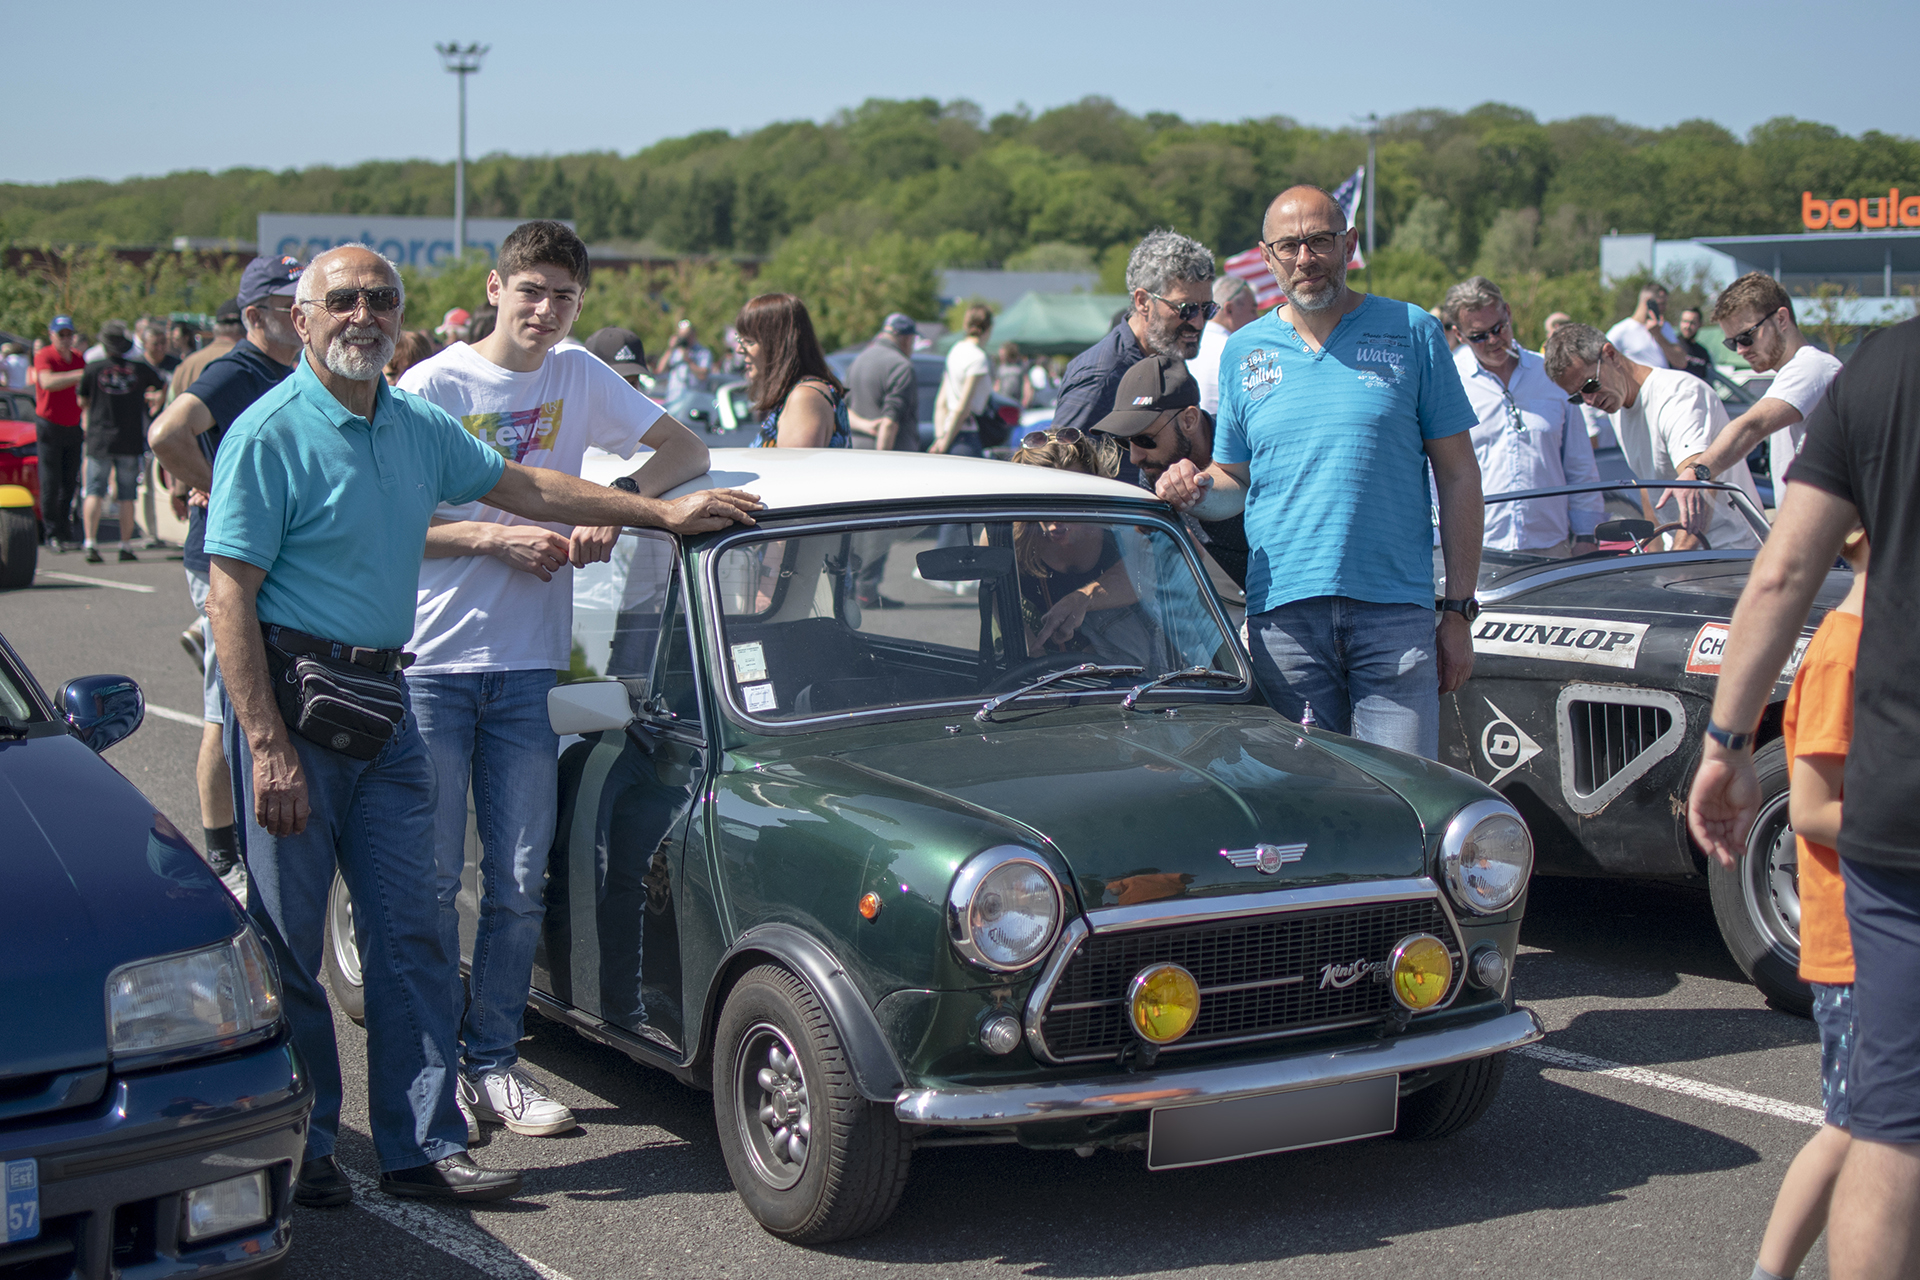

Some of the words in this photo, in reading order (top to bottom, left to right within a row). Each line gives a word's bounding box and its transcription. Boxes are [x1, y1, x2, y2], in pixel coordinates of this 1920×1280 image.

[1356, 347, 1404, 365] Water
[1241, 365, 1283, 392] Sailing
[1473, 621, 1635, 652] DUNLOP
[1489, 733, 1519, 756] D
[10, 1165, 33, 1174] Grand
[10, 1171, 33, 1186] Est
[9, 1201, 37, 1230] 57
